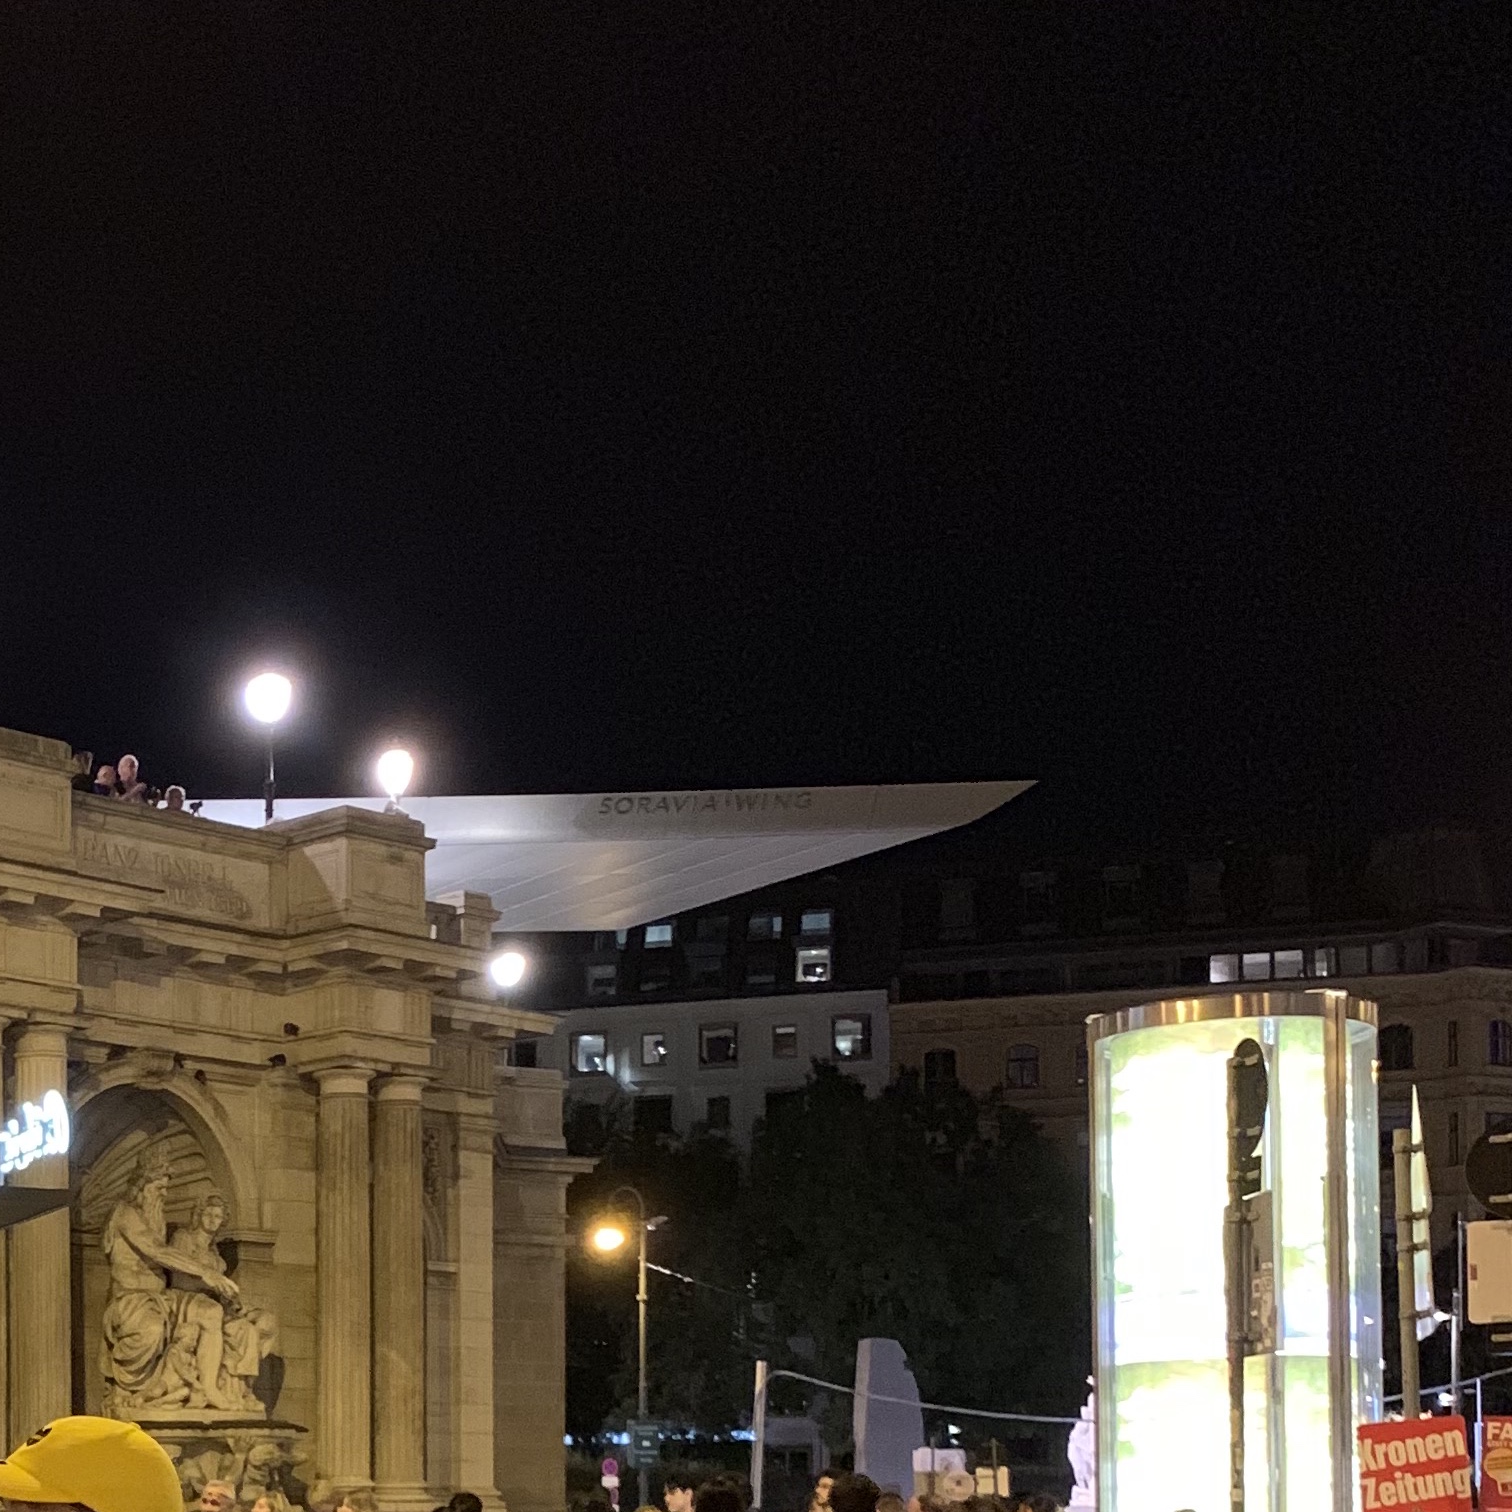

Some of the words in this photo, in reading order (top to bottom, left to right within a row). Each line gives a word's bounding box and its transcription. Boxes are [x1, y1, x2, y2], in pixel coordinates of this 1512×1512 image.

[598, 794, 717, 815] SORAVIA
[1358, 1428, 1466, 1474] Kronen
[1360, 1463, 1473, 1511] Zeitung
